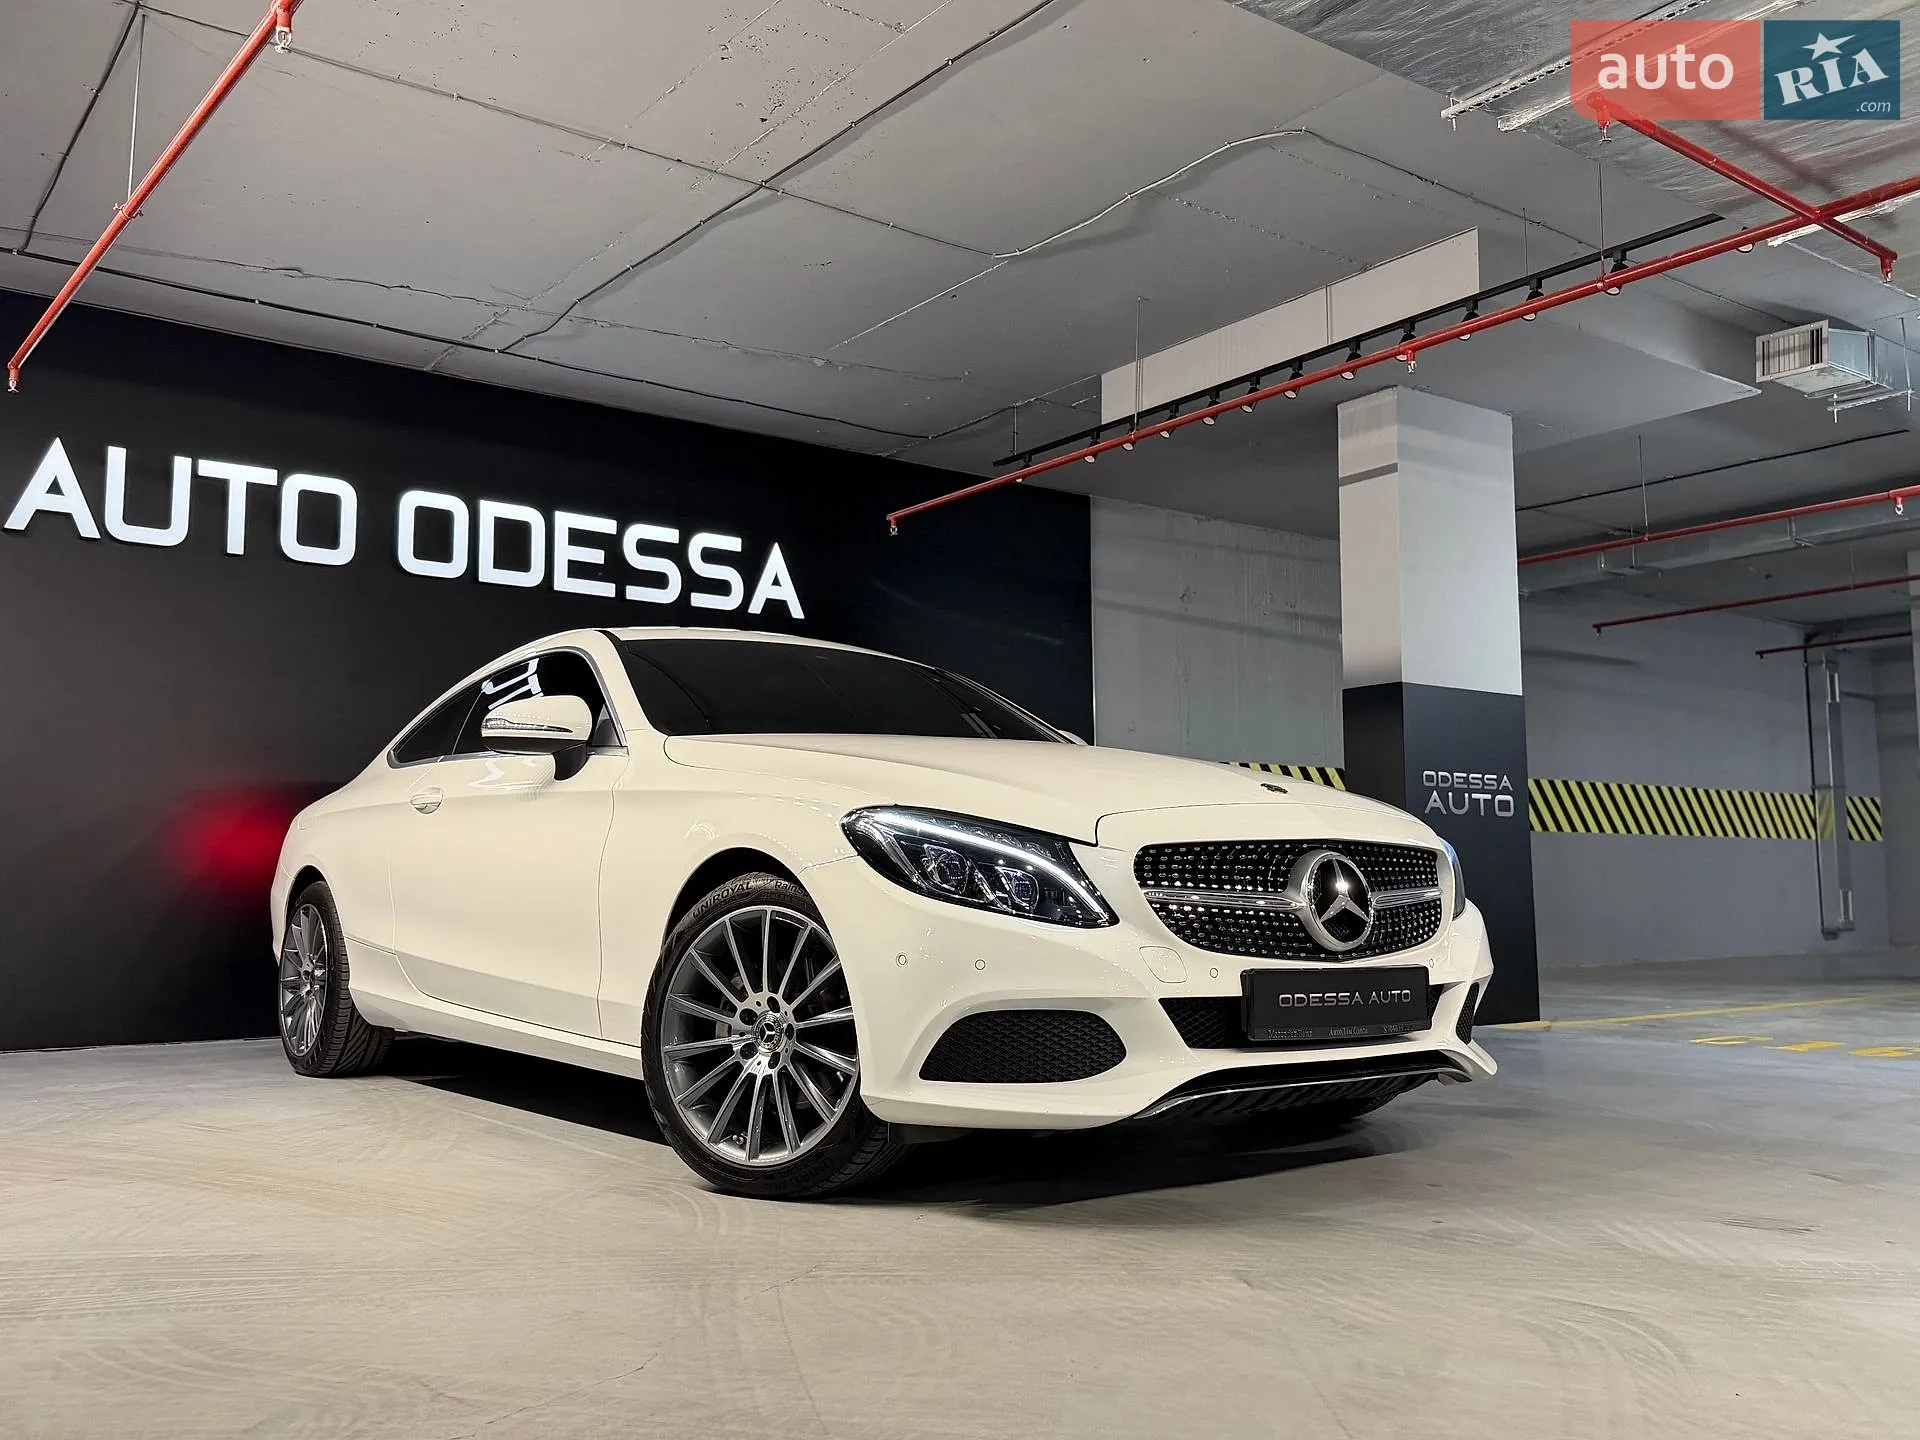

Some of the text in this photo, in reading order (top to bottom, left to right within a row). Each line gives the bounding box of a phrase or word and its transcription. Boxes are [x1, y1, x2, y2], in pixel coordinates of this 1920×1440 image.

[3, 437, 804, 619] AUTO ODESSA
[1422, 770, 1513, 791] ODESSA
[1424, 790, 1514, 817] AUTO
[692, 882, 752, 919] UNIROYAL
[1278, 990, 1411, 1007] ODESSA AUTO
